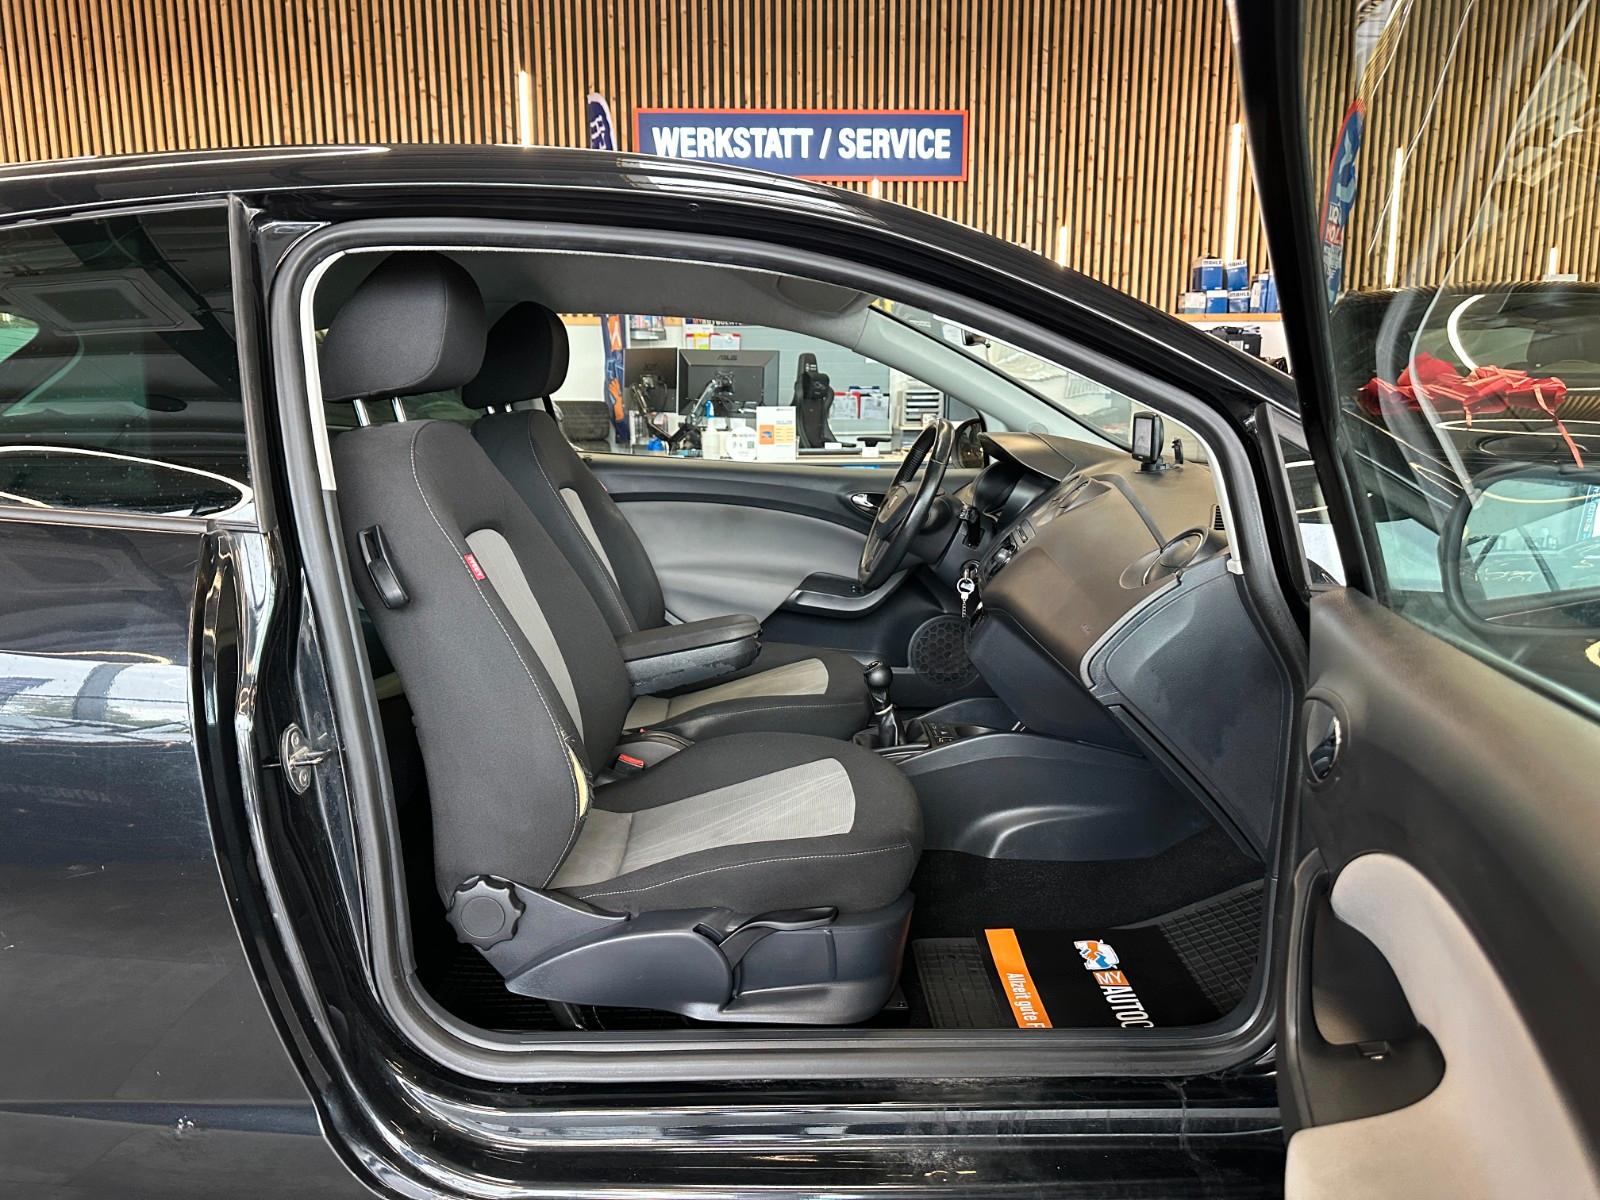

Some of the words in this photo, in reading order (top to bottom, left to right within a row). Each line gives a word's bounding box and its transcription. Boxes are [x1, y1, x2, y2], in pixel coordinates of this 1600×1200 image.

[652, 126, 813, 158] WERKSTATT
[818, 127, 830, 159] /
[837, 127, 951, 159] SERVICE
[1006, 973, 1031, 999] Allzeit
[1095, 971, 1122, 985] MY
[1013, 1001, 1039, 1021] gute
